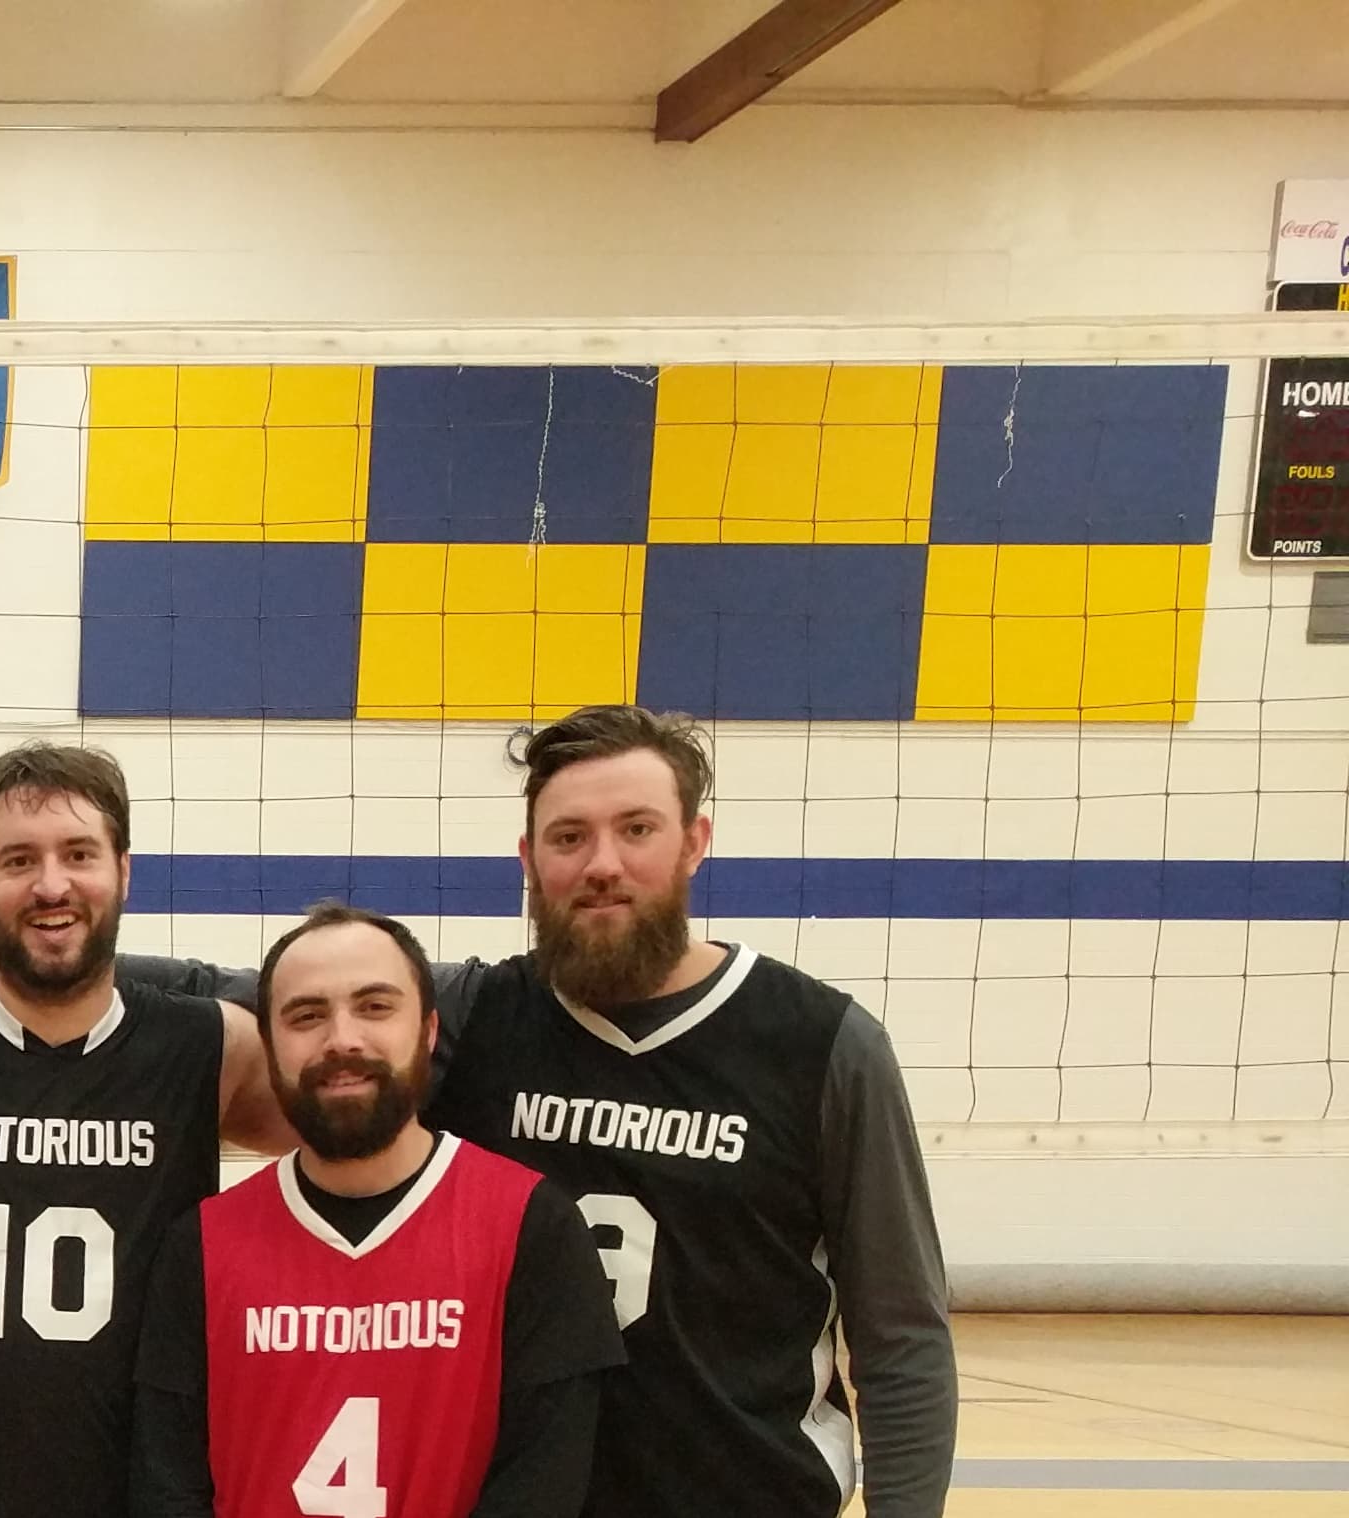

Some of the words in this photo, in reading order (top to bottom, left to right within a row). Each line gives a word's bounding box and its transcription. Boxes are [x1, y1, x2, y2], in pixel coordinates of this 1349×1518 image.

[1288, 465, 1335, 479] FOULS
[1273, 540, 1322, 554] POINTS
[511, 1091, 749, 1164] NOTORIOUS
[245, 1299, 465, 1354] NOTORIOUS
